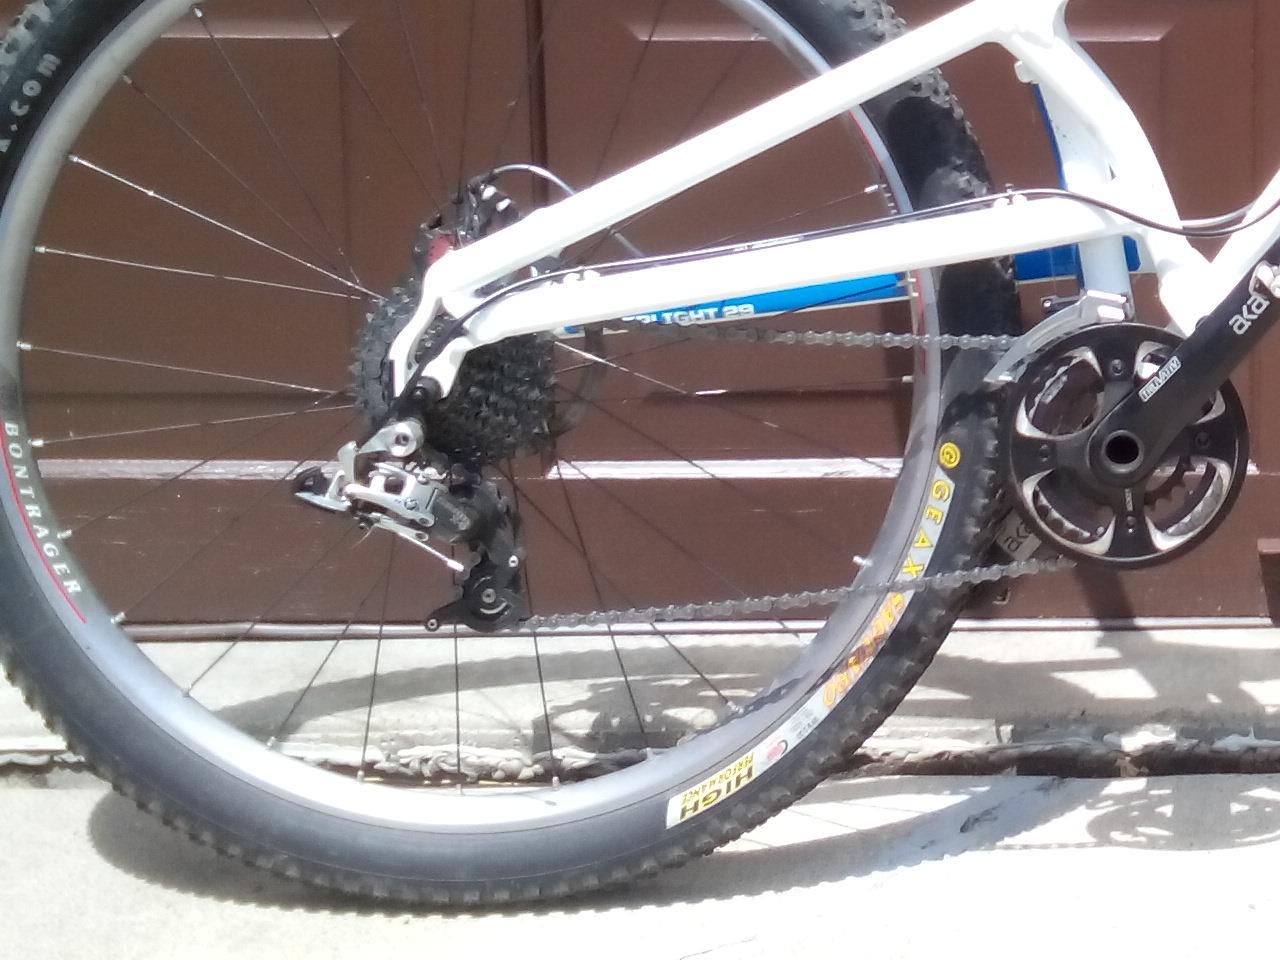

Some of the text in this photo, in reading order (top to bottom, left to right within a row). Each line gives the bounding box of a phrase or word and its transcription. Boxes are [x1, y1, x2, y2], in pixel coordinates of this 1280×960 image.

[723, 303, 755, 320] 29
[3, 421, 82, 594] BONTRAGER
[902, 479, 952, 577] GEAX
[680, 766, 754, 823] HIGH
